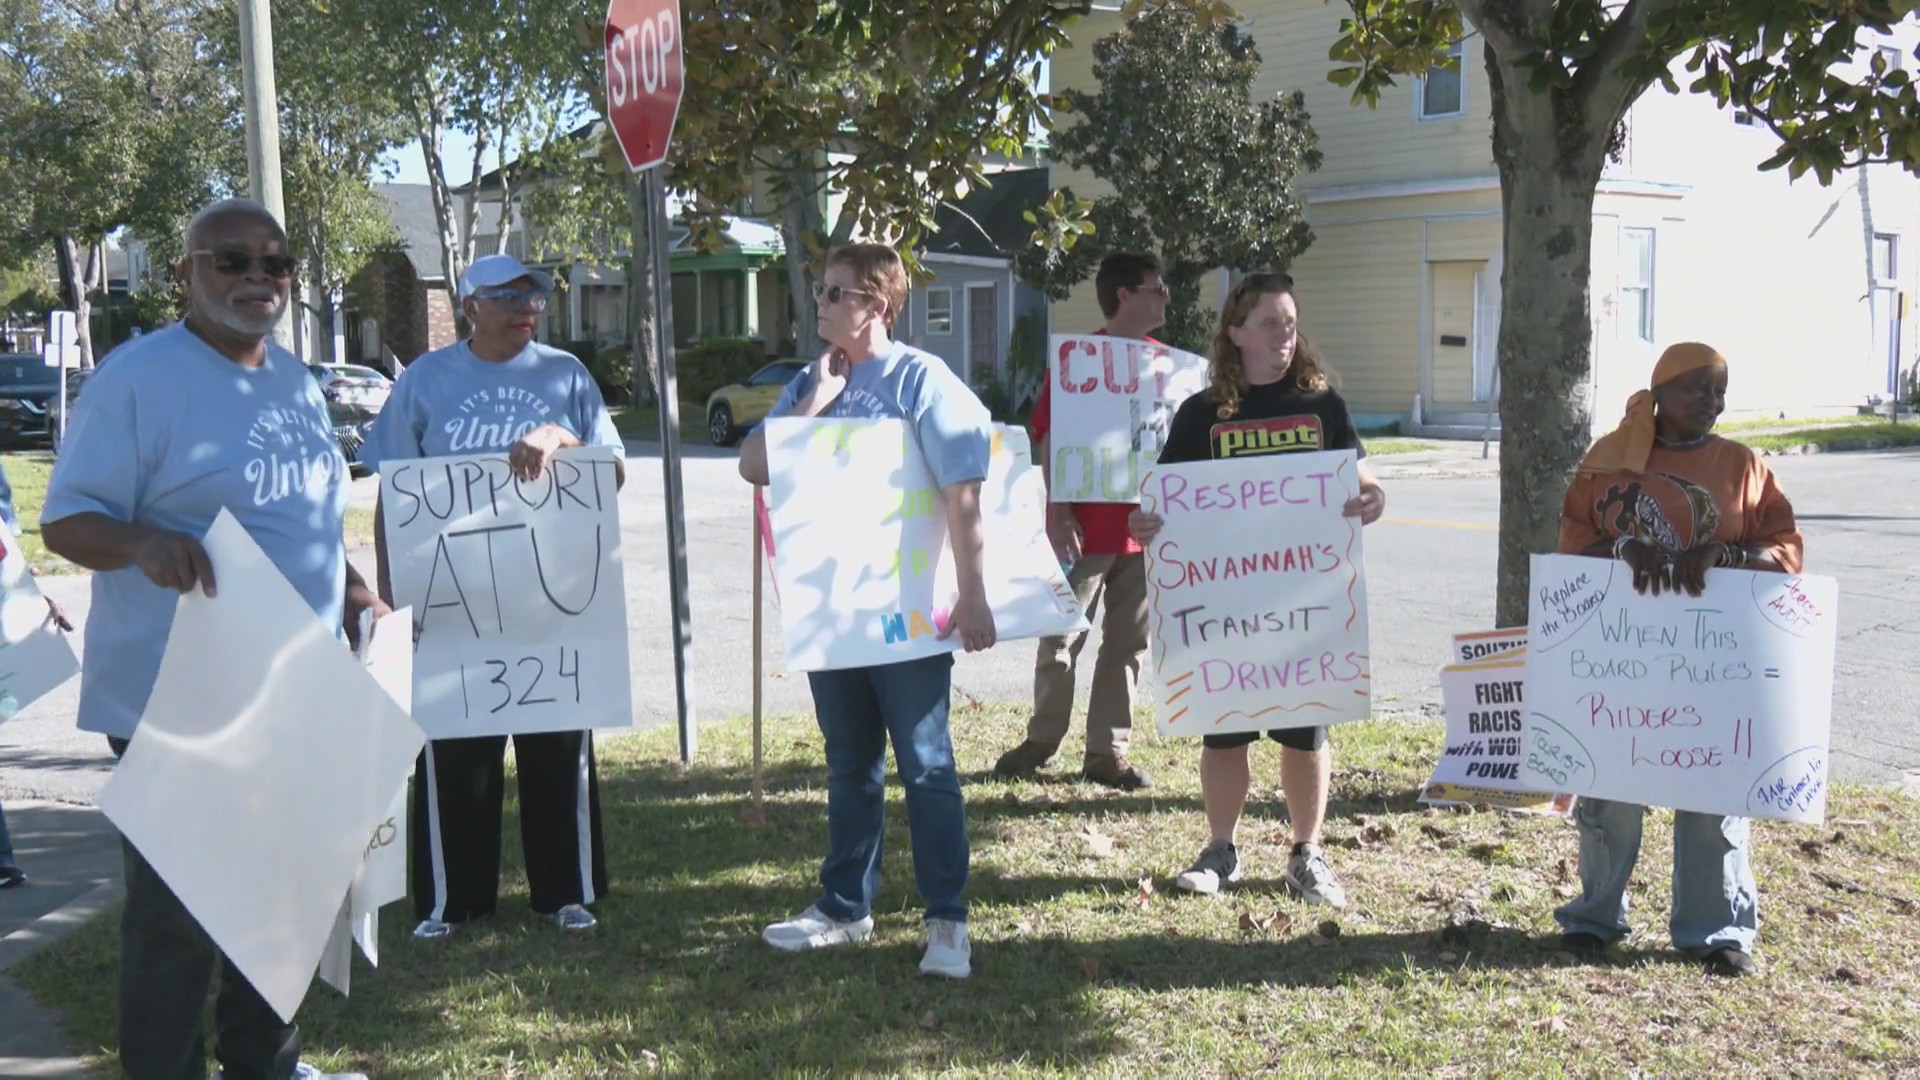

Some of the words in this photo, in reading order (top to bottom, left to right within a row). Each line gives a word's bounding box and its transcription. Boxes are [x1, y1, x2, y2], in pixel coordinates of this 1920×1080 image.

[612, 9, 675, 108] STOP
[1059, 340, 1170, 397] CUT
[460, 389, 490, 413] IT'S
[498, 386, 551, 416] BETTER
[494, 404, 506, 413] IN
[510, 404, 517, 413] A
[247, 415, 272, 450] IT'S
[443, 415, 546, 452] Unio
[1055, 446, 1157, 500] OU
[1160, 472, 1334, 514] RESPECT
[392, 459, 615, 529] SUPPORT
[1158, 541, 1340, 590] SAVANNAH'S
[414, 524, 601, 653] ATU
[1540, 572, 1591, 612] Replace
[460, 646, 580, 719] 1324
[1199, 651, 1361, 693] DRIVERS
[1570, 649, 1648, 680] BOARD
[1475, 681, 1523, 705] FIGHT
[1576, 692, 1702, 729] RIDERS
[1445, 740, 1484, 756] with
[1488, 737, 1521, 756] WO
